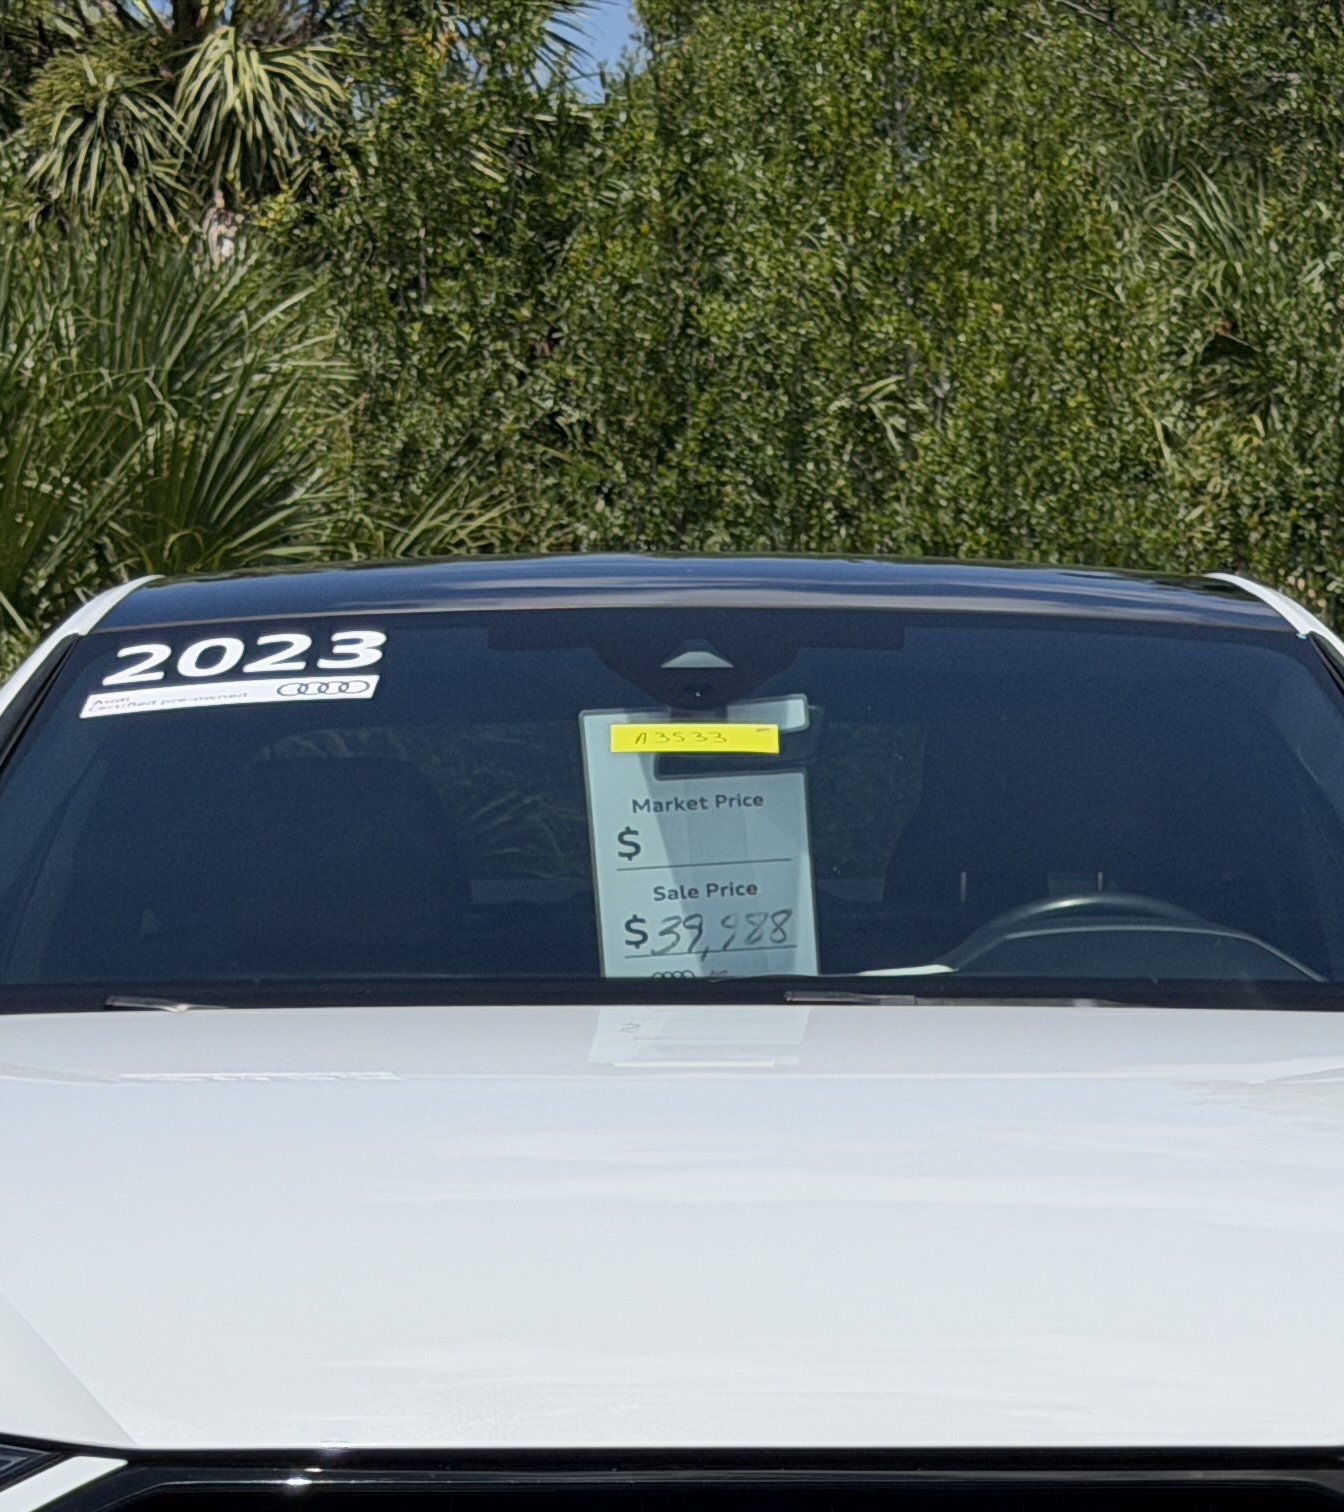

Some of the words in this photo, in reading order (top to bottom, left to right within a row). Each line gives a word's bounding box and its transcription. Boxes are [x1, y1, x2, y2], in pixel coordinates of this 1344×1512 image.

[102, 630, 387, 686] 2023
[632, 796, 709, 814] Market
[715, 793, 764, 809] Price
[617, 826, 641, 861] $
[653, 884, 699, 902] Sale
[706, 882, 758, 898] Price
